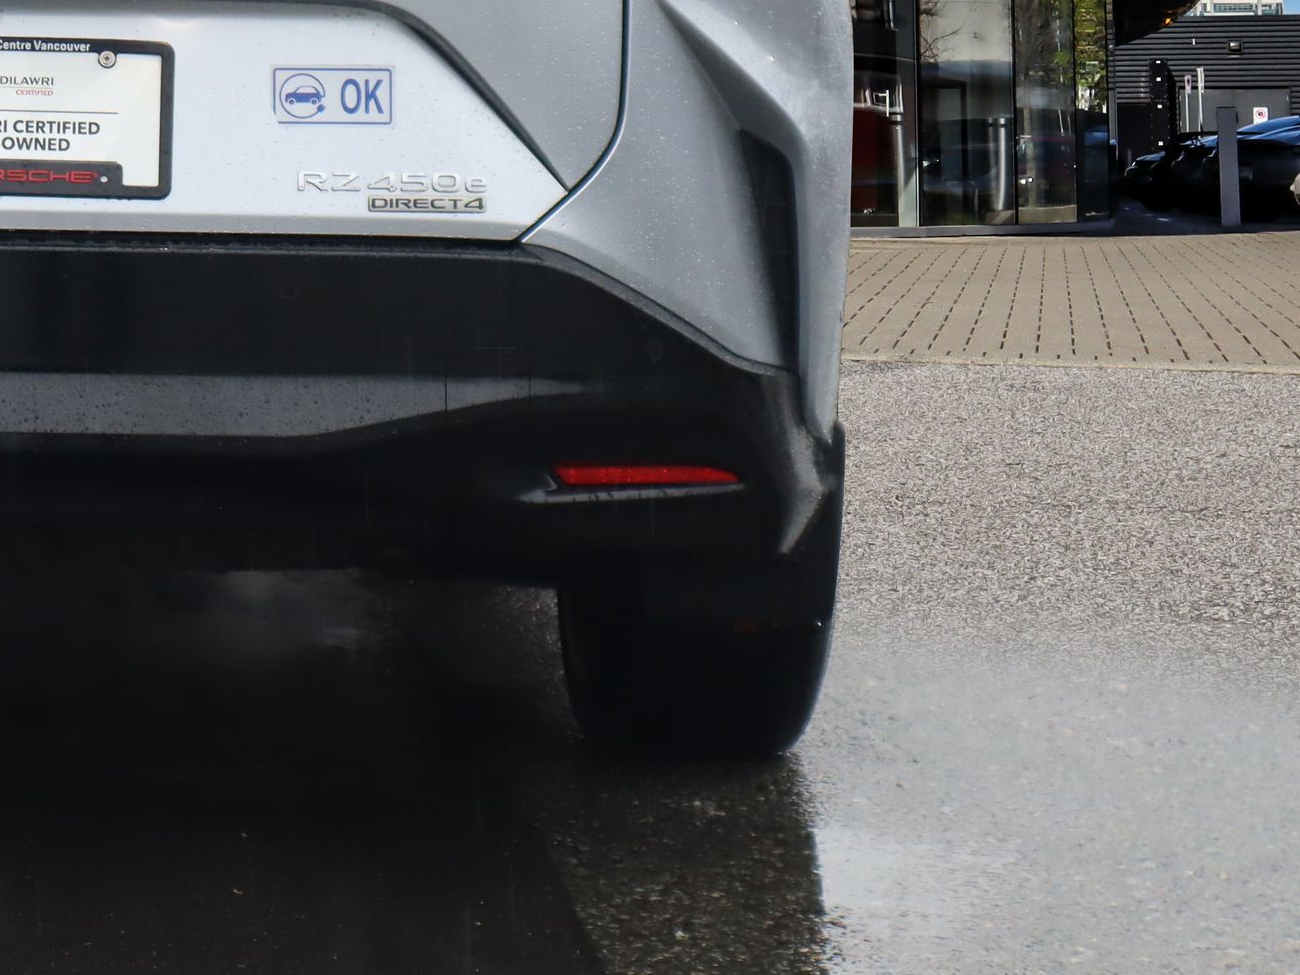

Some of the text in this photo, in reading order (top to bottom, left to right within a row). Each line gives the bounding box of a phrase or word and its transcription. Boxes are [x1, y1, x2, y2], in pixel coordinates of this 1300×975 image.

[34, 40, 91, 53] Vancouver
[0, 75, 54, 87] DILAWRI
[15, 89, 54, 97] CERTIFIED
[340, 78, 384, 115] OK
[12, 119, 101, 136] CERTIFIED
[370, 196, 485, 211] DIRECT4
